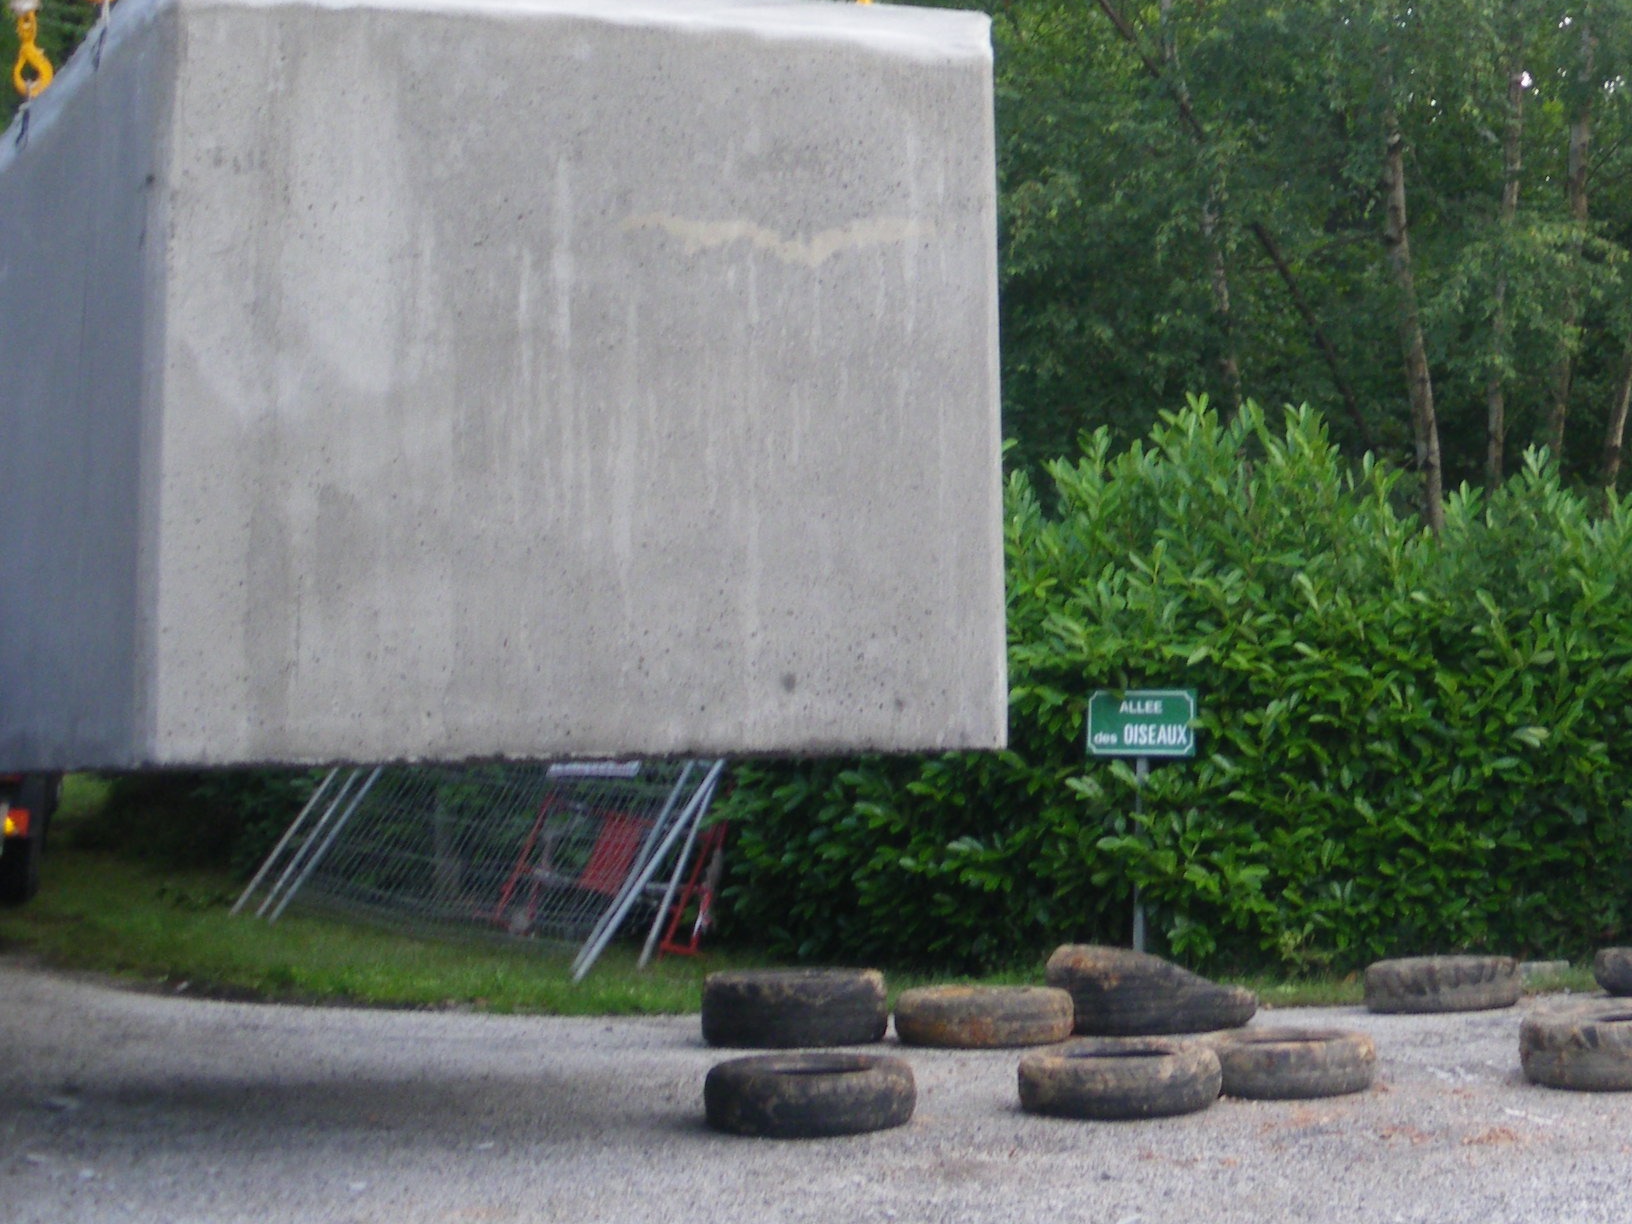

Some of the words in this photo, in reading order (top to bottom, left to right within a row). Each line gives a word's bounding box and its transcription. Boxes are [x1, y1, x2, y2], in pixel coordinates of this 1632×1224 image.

[1119, 699, 1163, 714] ALLEE
[1094, 731, 1117, 745] des
[1123, 723, 1187, 745] OISEAUX
